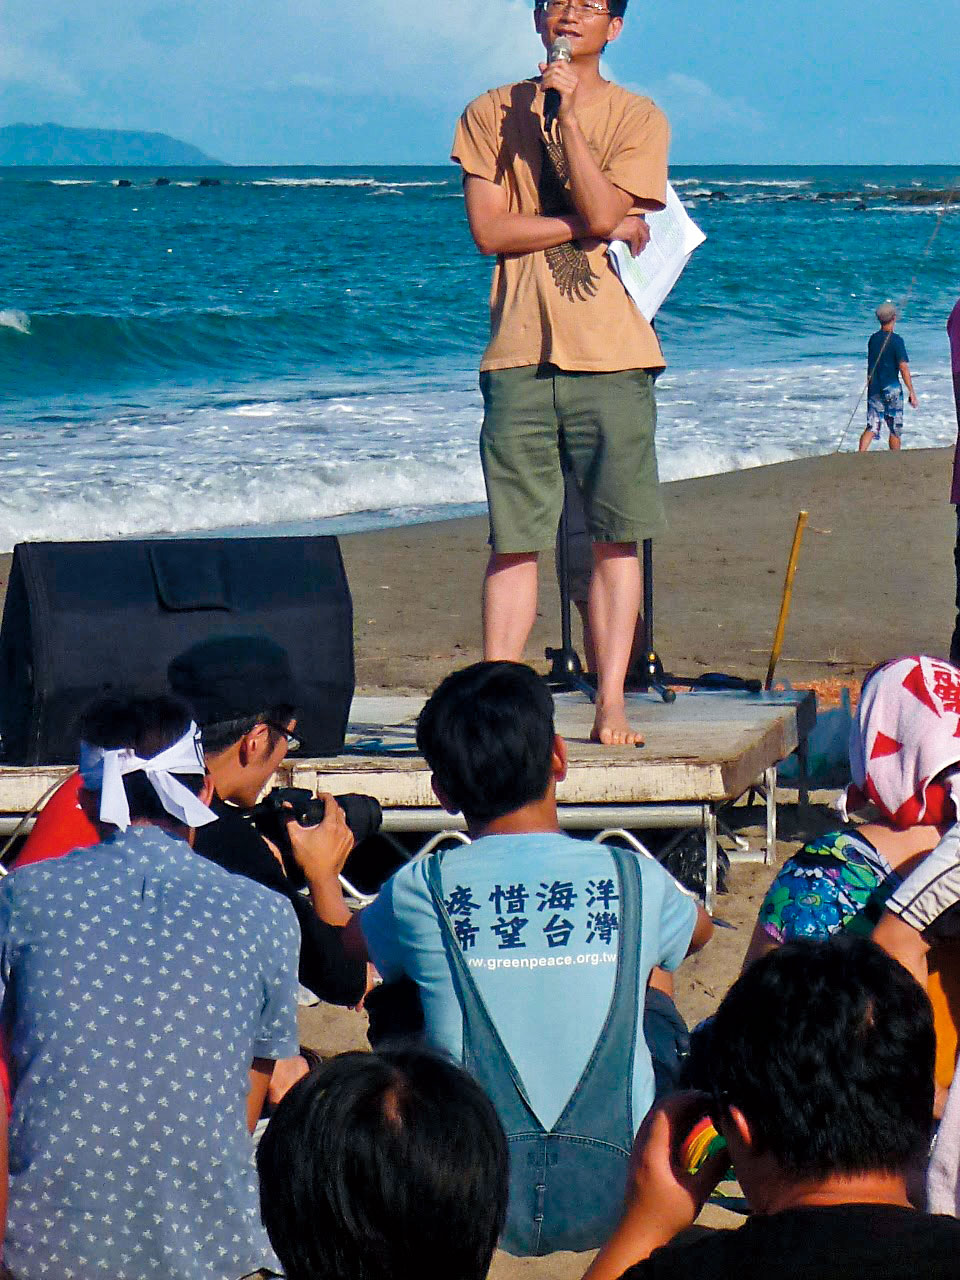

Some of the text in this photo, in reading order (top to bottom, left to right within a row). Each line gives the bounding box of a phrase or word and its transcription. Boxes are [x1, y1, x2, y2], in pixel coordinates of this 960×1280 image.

[446, 879, 619, 916] 疼惜海洋
[454, 912, 619, 951] 希望台灣
[468, 951, 617, 970] w.greenpeace.org.tw
